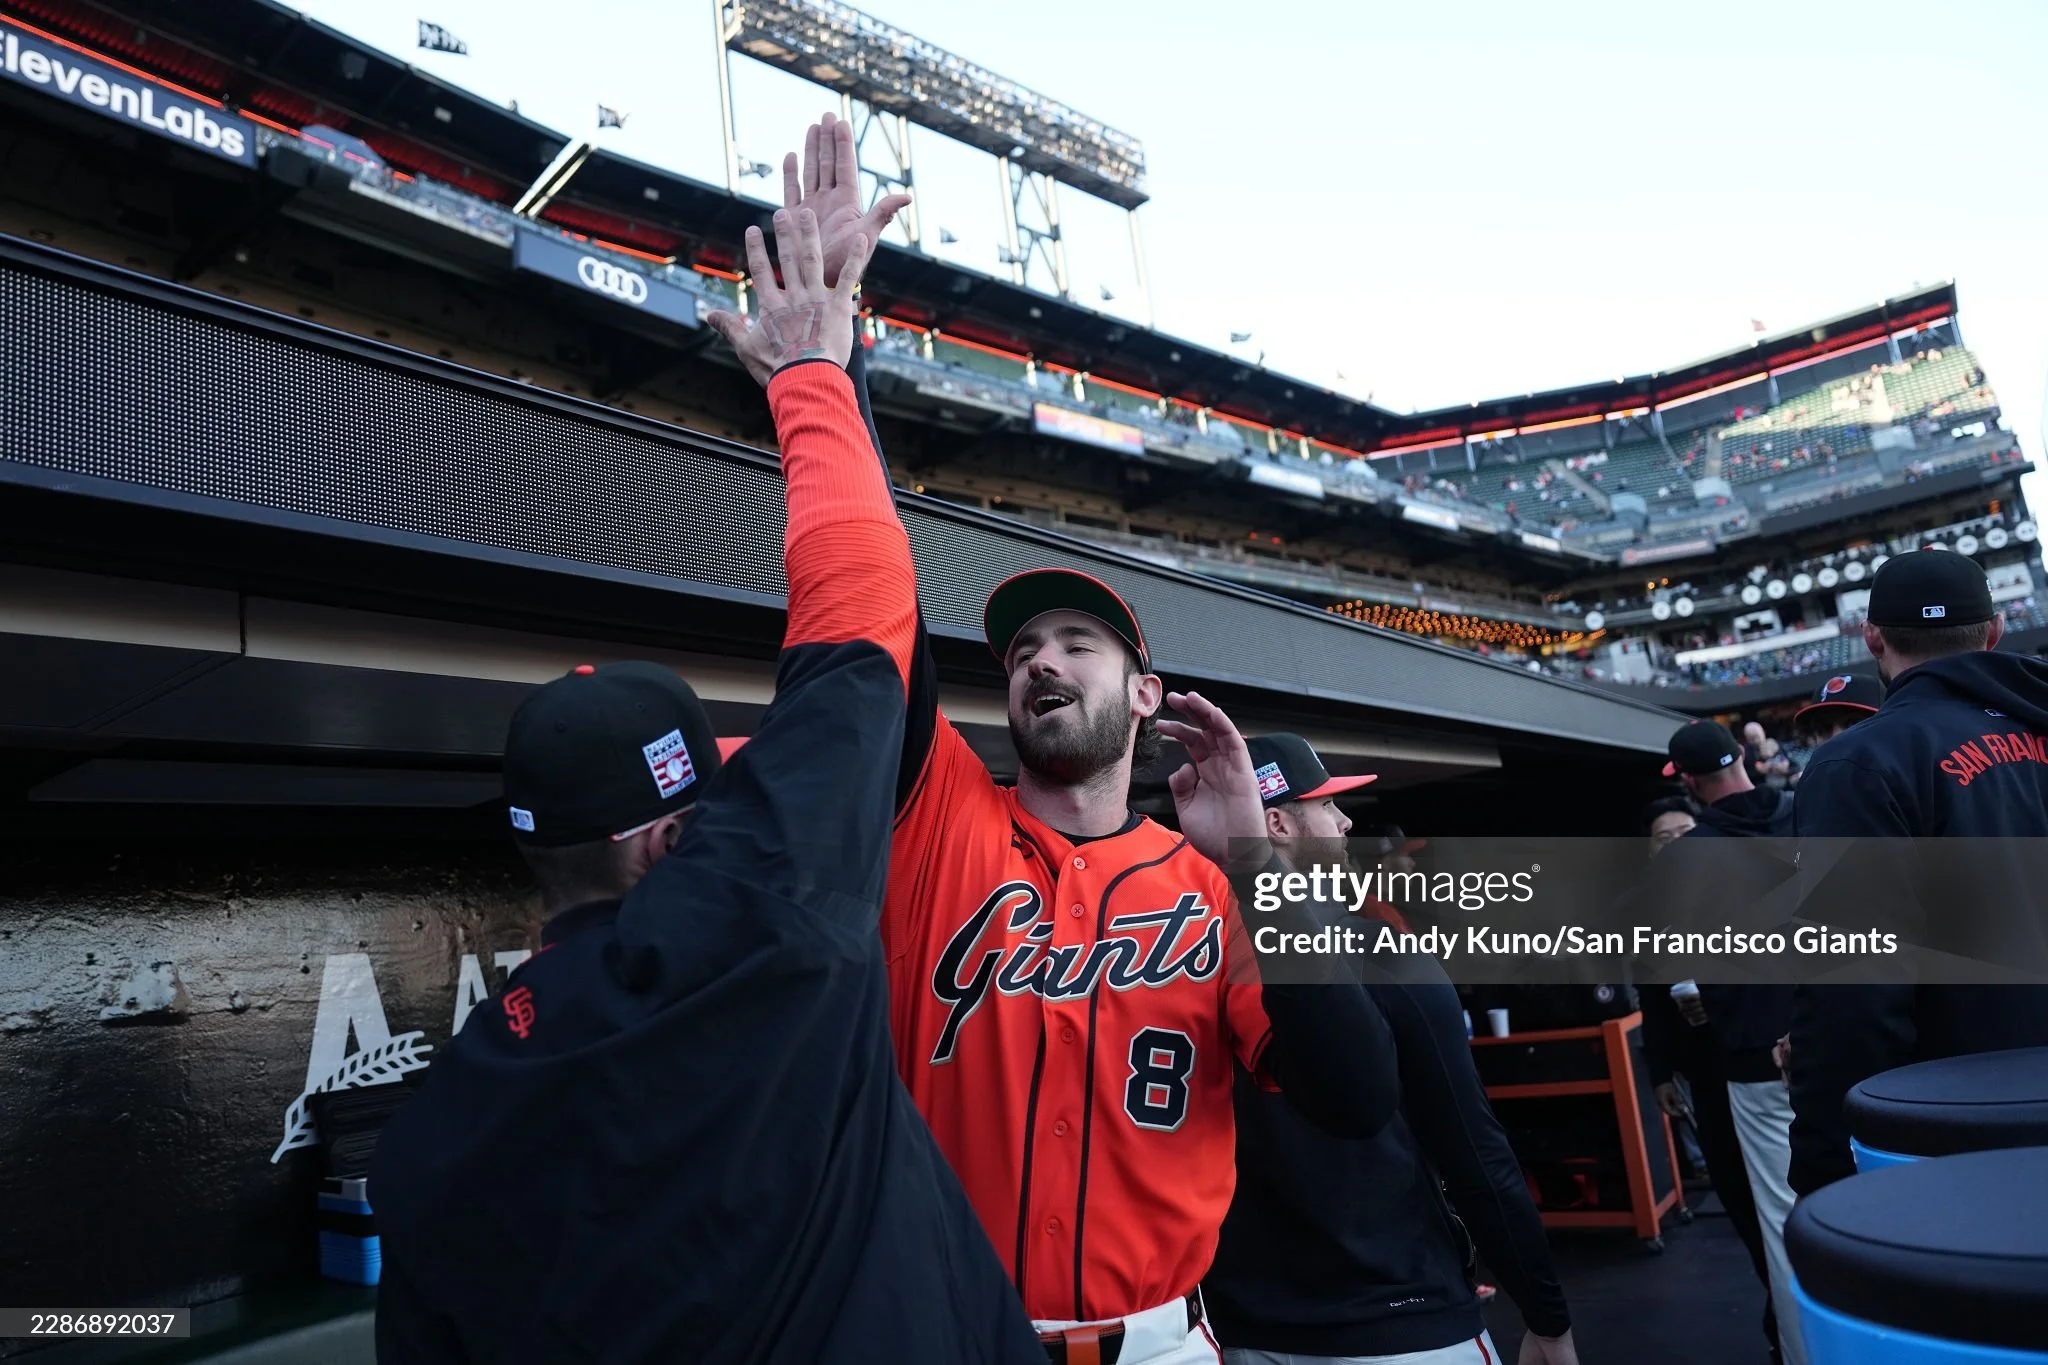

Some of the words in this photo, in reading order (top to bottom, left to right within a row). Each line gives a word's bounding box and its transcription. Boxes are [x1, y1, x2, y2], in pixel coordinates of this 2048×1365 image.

[0, 29, 246, 157] levenLabs
[1940, 740, 1993, 786] SAN
[929, 880, 1224, 1066] Giants
[1123, 1026, 1196, 1132] 8
